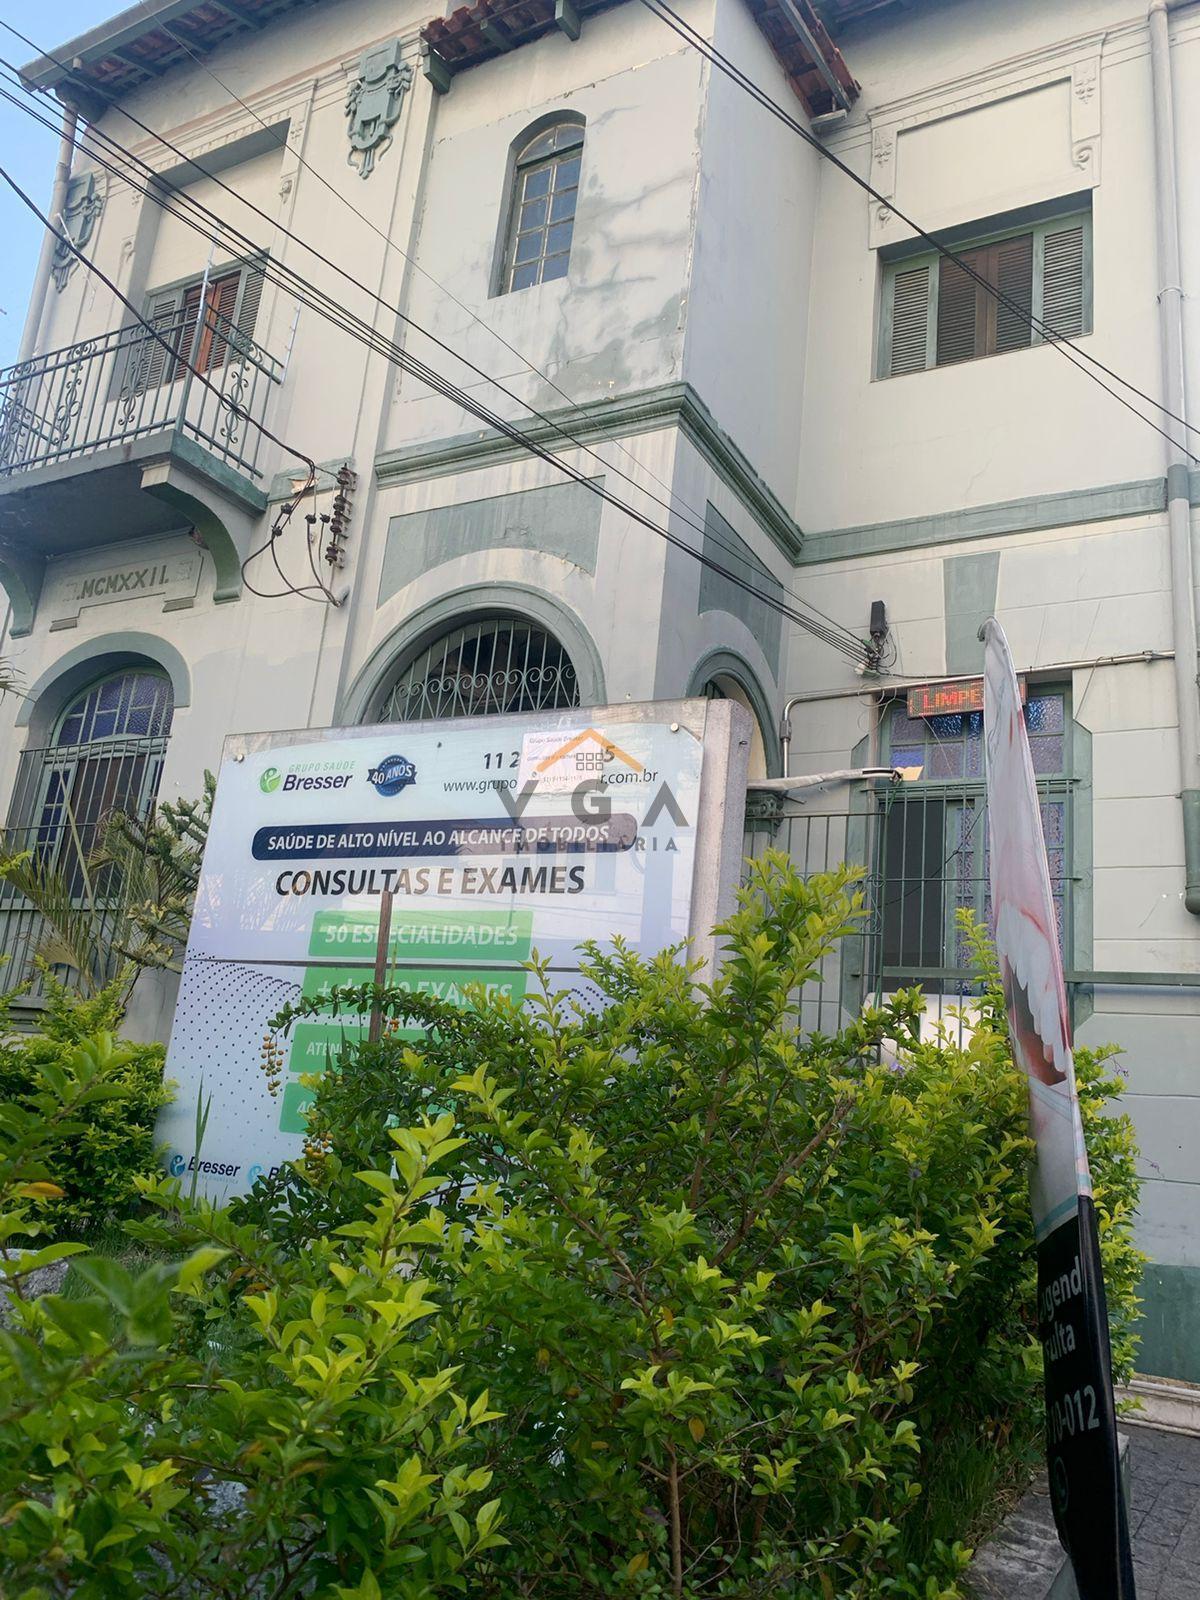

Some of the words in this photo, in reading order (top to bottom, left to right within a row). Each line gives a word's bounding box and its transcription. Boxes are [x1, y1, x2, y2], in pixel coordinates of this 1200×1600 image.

[923, 688, 984, 709] LIMPE
[289, 762, 320, 773] GRUPO
[372, 771, 385, 784] 40
[385, 764, 413, 782] ANOS
[282, 774, 353, 791] Bresser
[268, 832, 314, 850] SAÚDE
[316, 834, 335, 849] DE
[338, 832, 374, 848] ALTO
[377, 829, 419, 847] NÍVEL
[422, 830, 445, 846] AO
[448, 828, 522, 846] ALCANCE
[525, 827, 547, 843] DE
[550, 825, 609, 842] TODOS
[275, 868, 430, 897] CONSULTAS
[437, 868, 454, 894] E
[460, 865, 585, 894] EXAMES
[325, 925, 348, 943] 50
[352, 924, 518, 946] ESECIALIDADES
